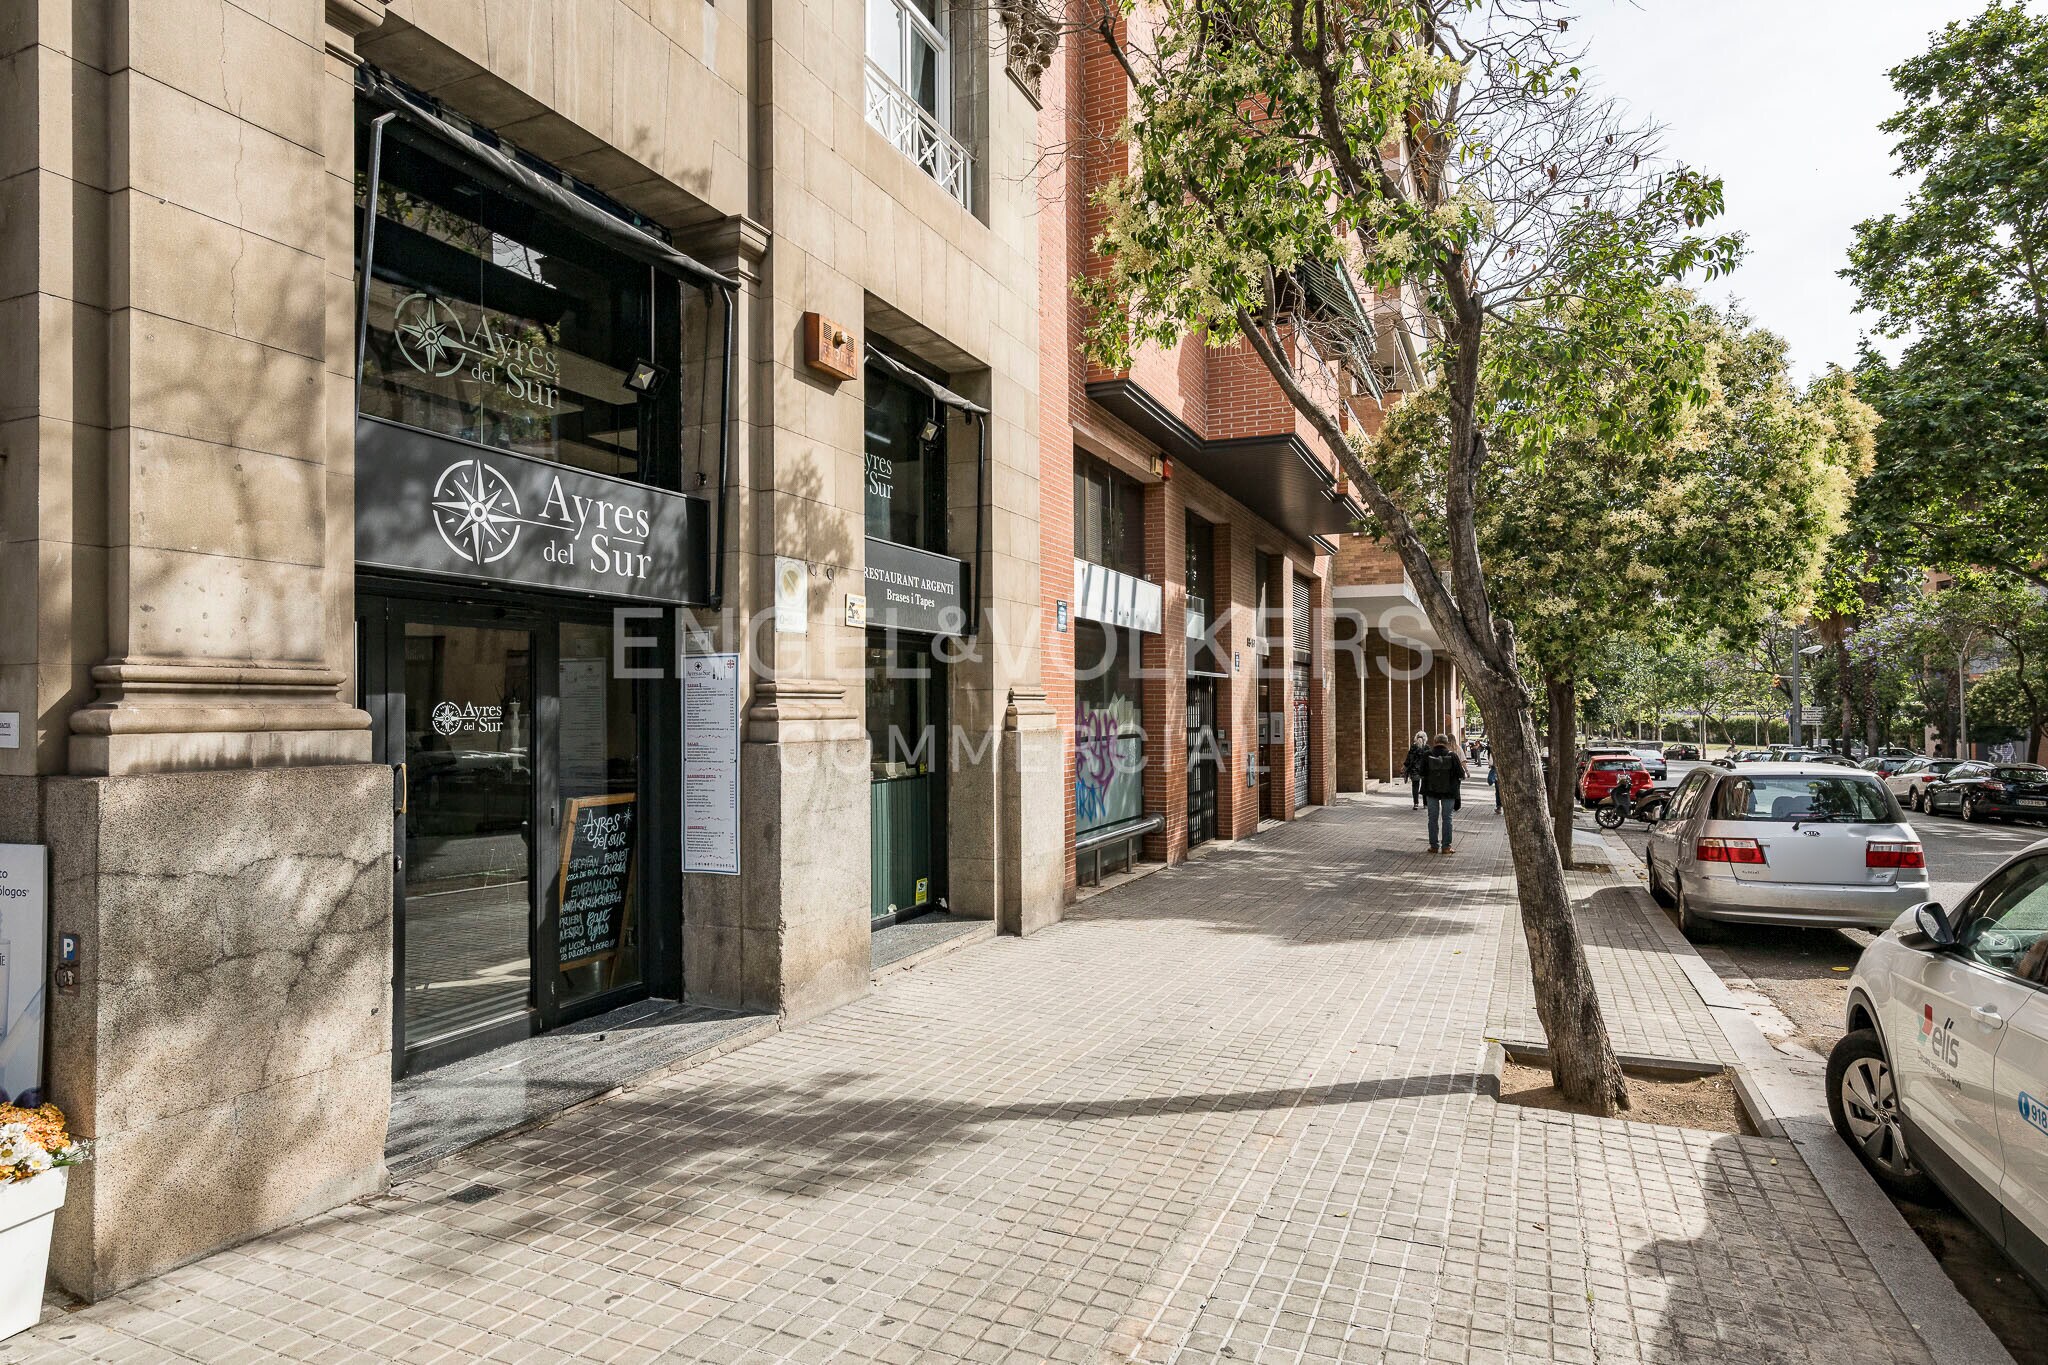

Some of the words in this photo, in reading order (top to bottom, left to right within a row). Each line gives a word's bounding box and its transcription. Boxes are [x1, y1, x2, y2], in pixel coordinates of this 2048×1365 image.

[468, 314, 556, 374] Ayres
[471, 362, 496, 385] del
[506, 362, 559, 409] Sur
[864, 452, 892, 475] yres
[869, 470, 894, 499] Sur
[538, 475, 650, 541] Ayres
[543, 540, 575, 565] del
[591, 533, 652, 579] Sur
[864, 566, 919, 588] RESTAURANT
[886, 588, 910, 604] Brases
[915, 594, 935, 610] Tapes
[462, 701, 503, 721] Ayres
[463, 722, 475, 731] del
[479, 717, 504, 733] Sur
[63, 938, 74, 958] P
[2031, 1105, 2048, 1129] 918
